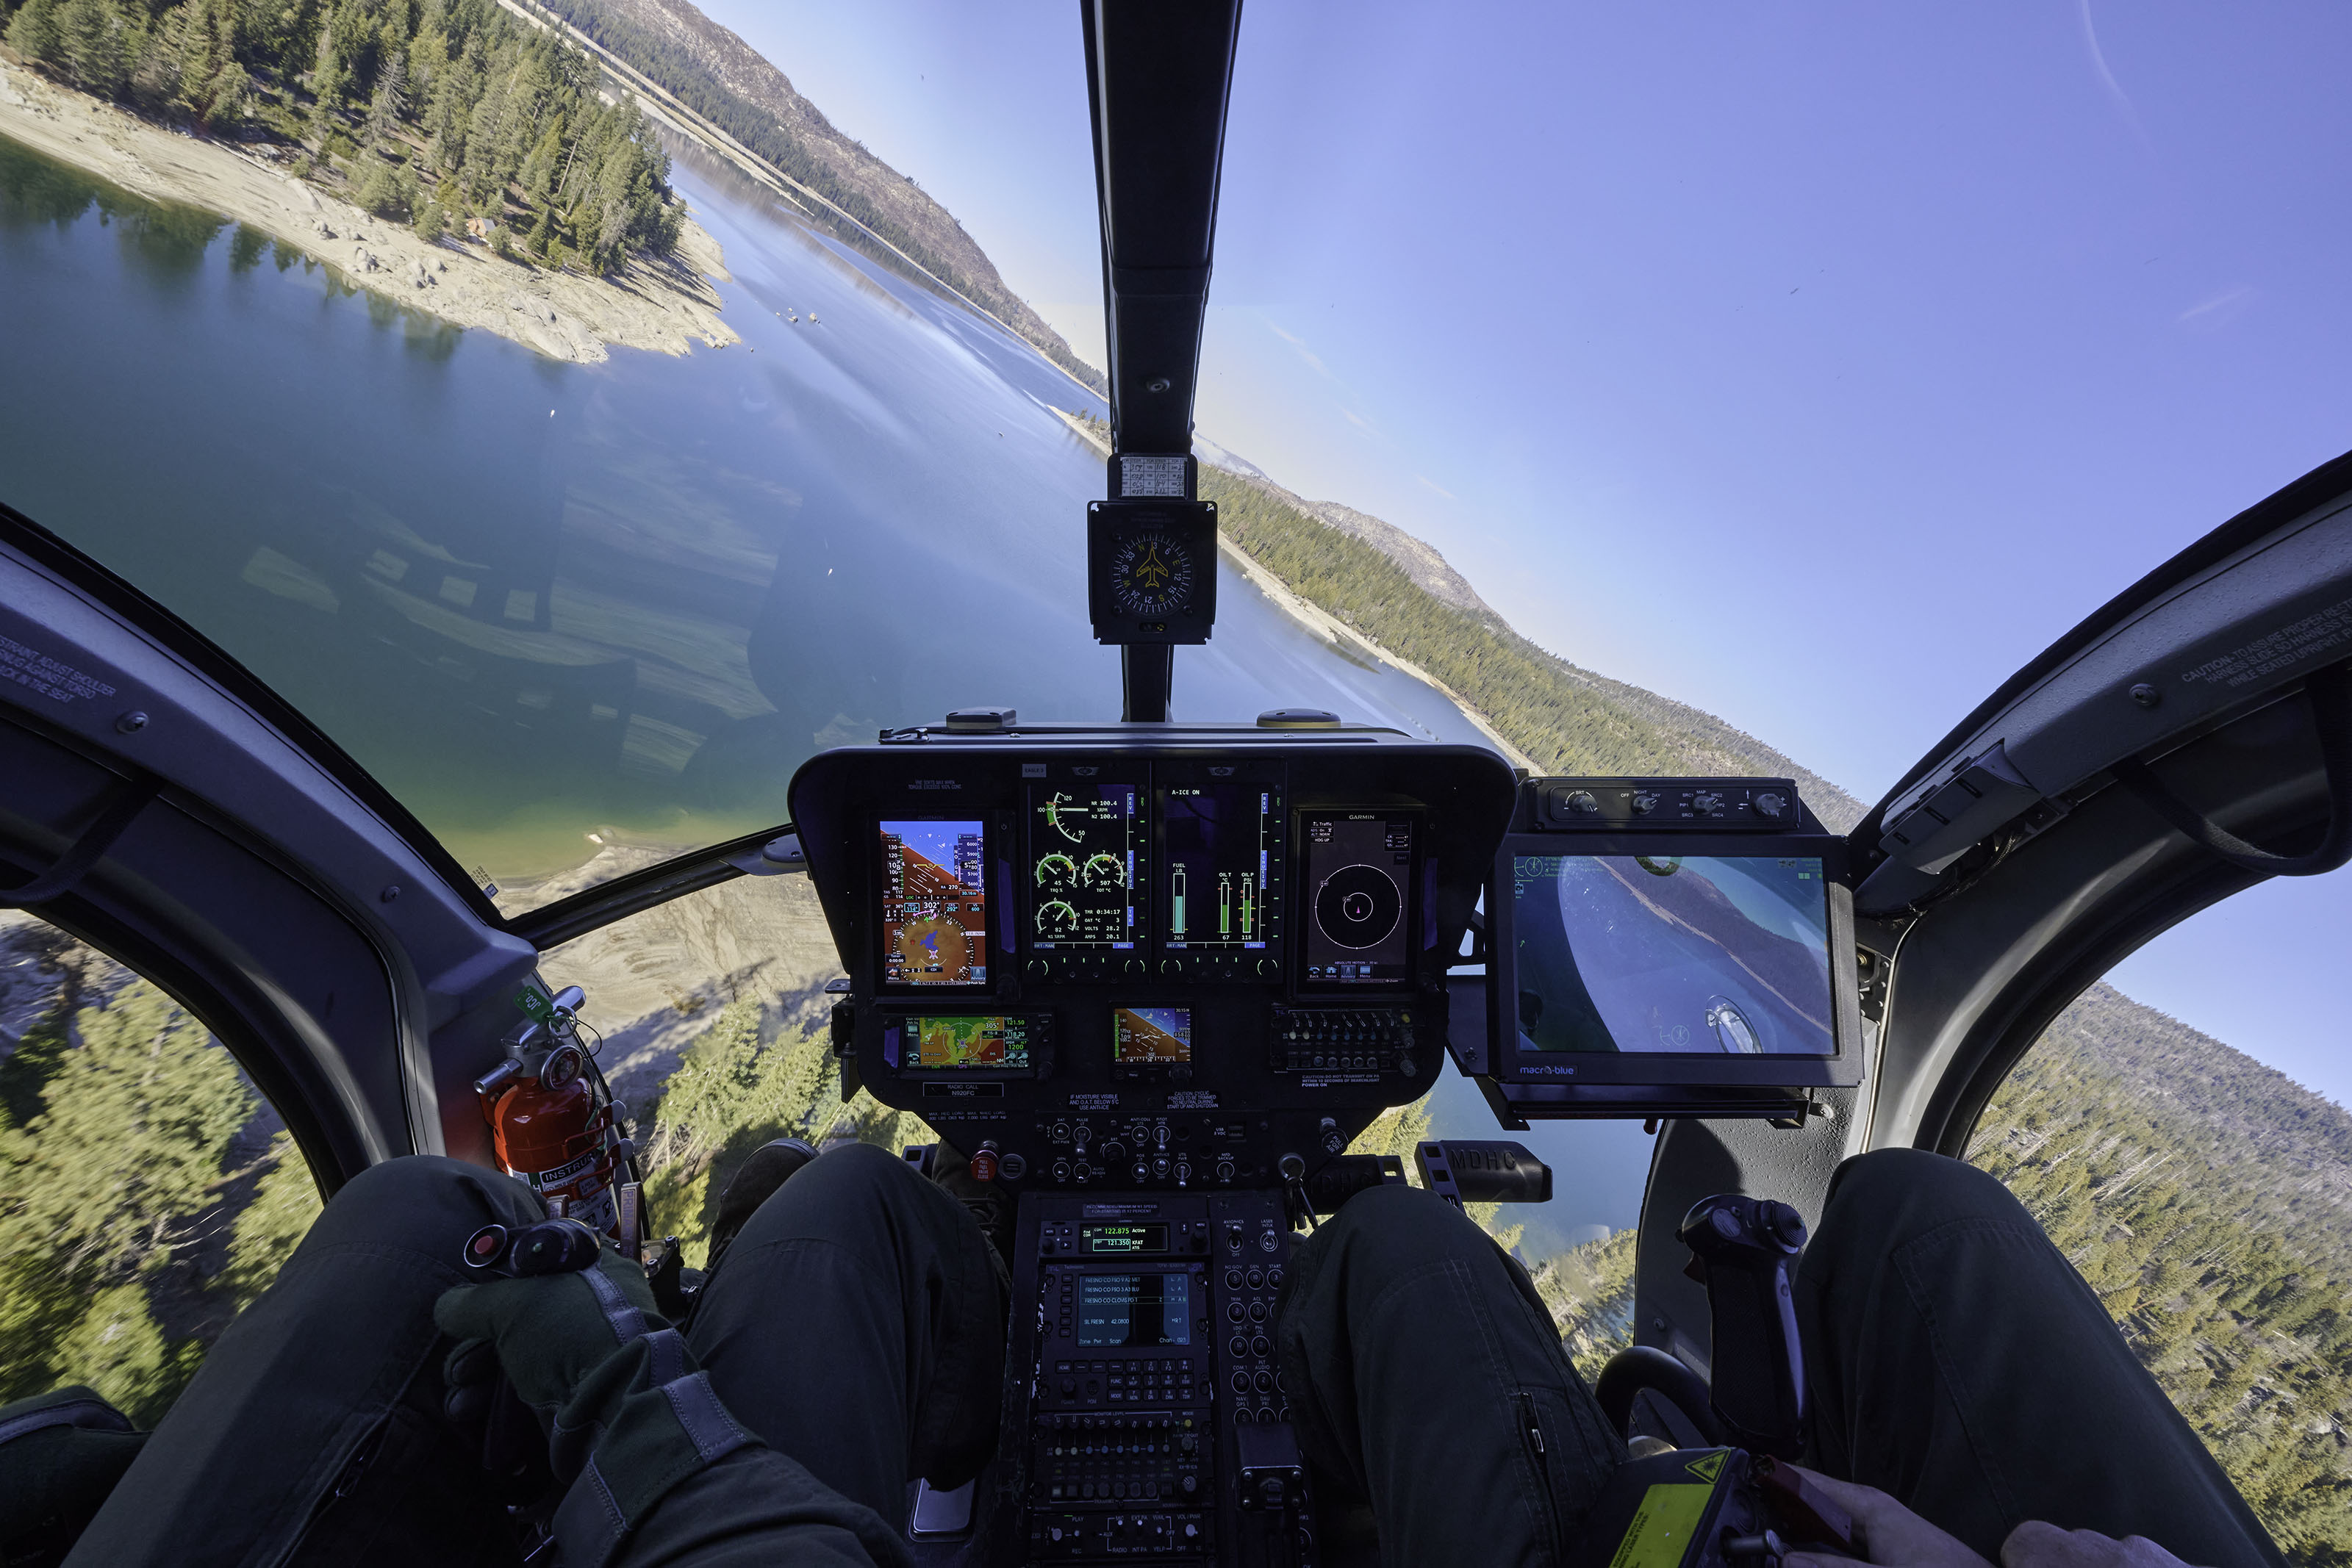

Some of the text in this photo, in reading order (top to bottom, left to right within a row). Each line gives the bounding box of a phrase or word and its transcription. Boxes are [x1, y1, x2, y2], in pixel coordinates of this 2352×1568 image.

[1126, 550, 1136, 561] 33
[1121, 564, 1130, 575] 30
[1174, 572, 1182, 581] 12
